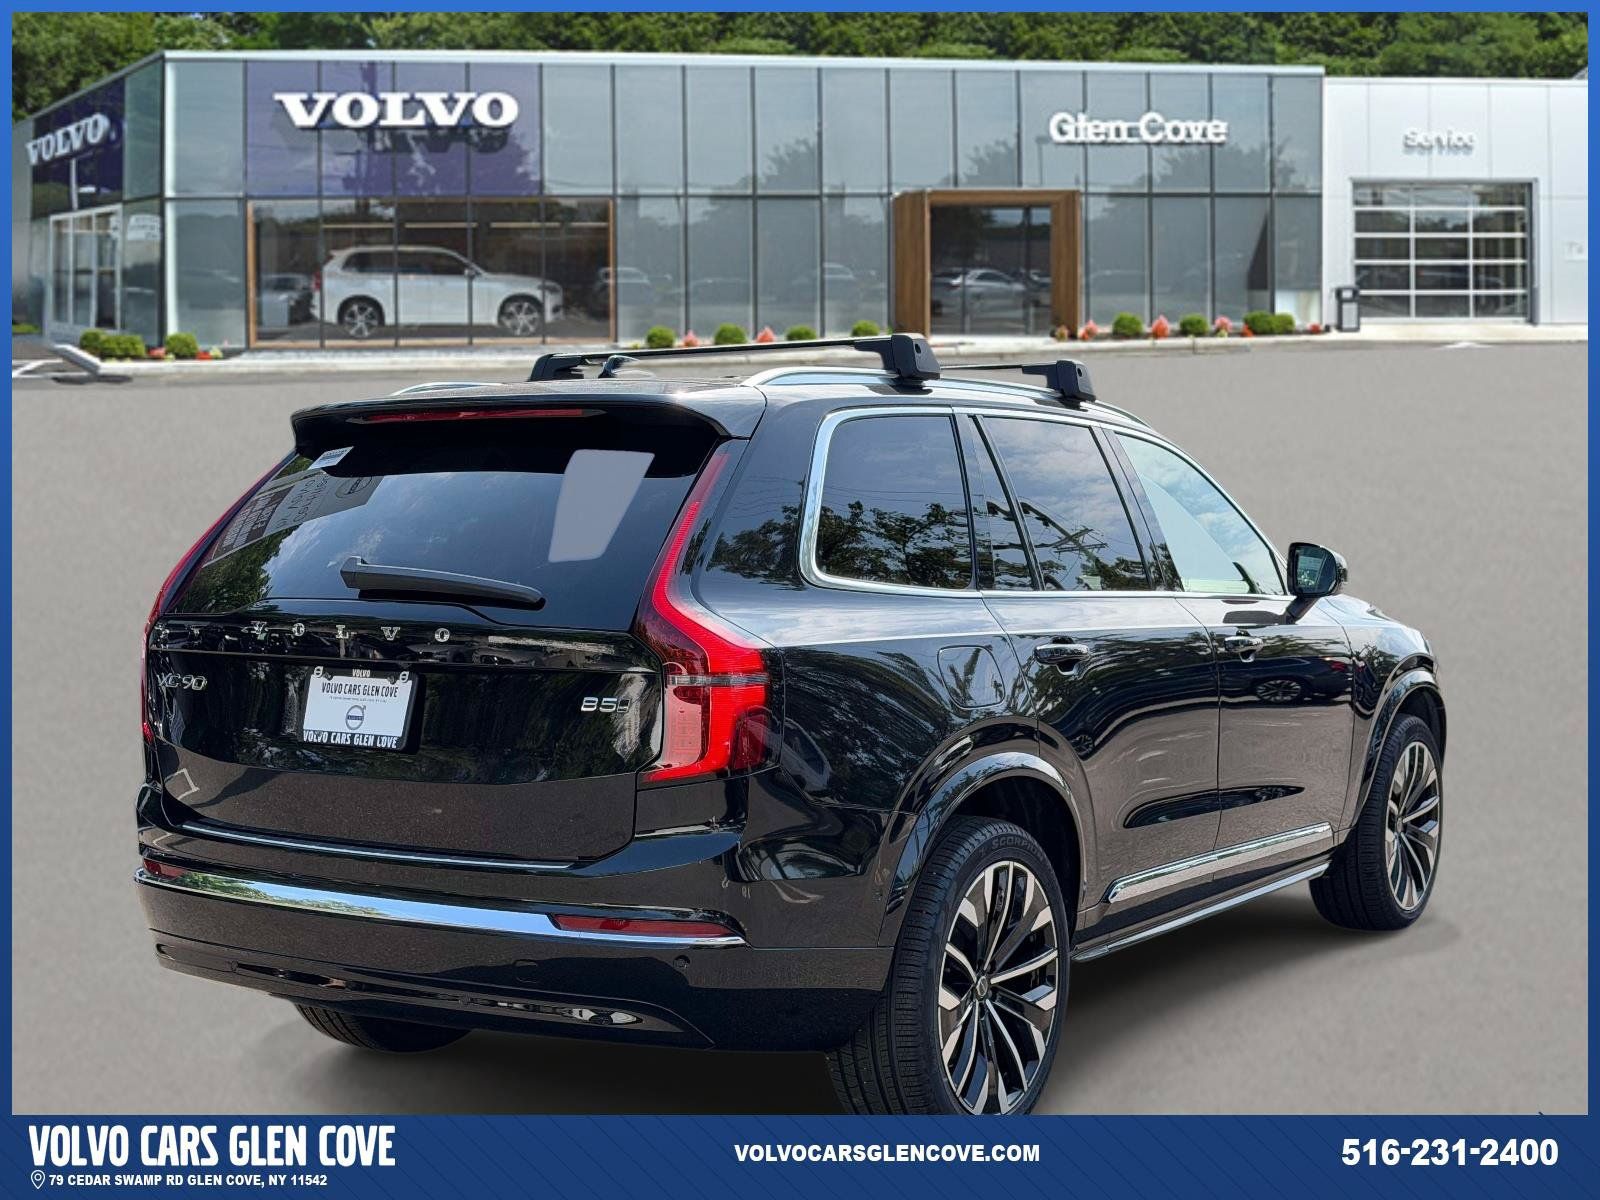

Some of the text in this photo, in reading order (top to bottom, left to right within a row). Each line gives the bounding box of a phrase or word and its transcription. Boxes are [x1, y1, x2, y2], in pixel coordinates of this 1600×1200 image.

[273, 92, 519, 127] VOLVO
[1049, 112, 1228, 143] Glen Cove
[26, 113, 110, 166] VOLVO
[1402, 128, 1476, 153] Service
[251, 621, 450, 643] VOLVO
[157, 672, 207, 690] XC90
[352, 668, 370, 678] VOLVO
[321, 682, 399, 698] VOLVO CARS GLEN COVE
[303, 730, 398, 749] VOLVO CARS GLEN COVE
